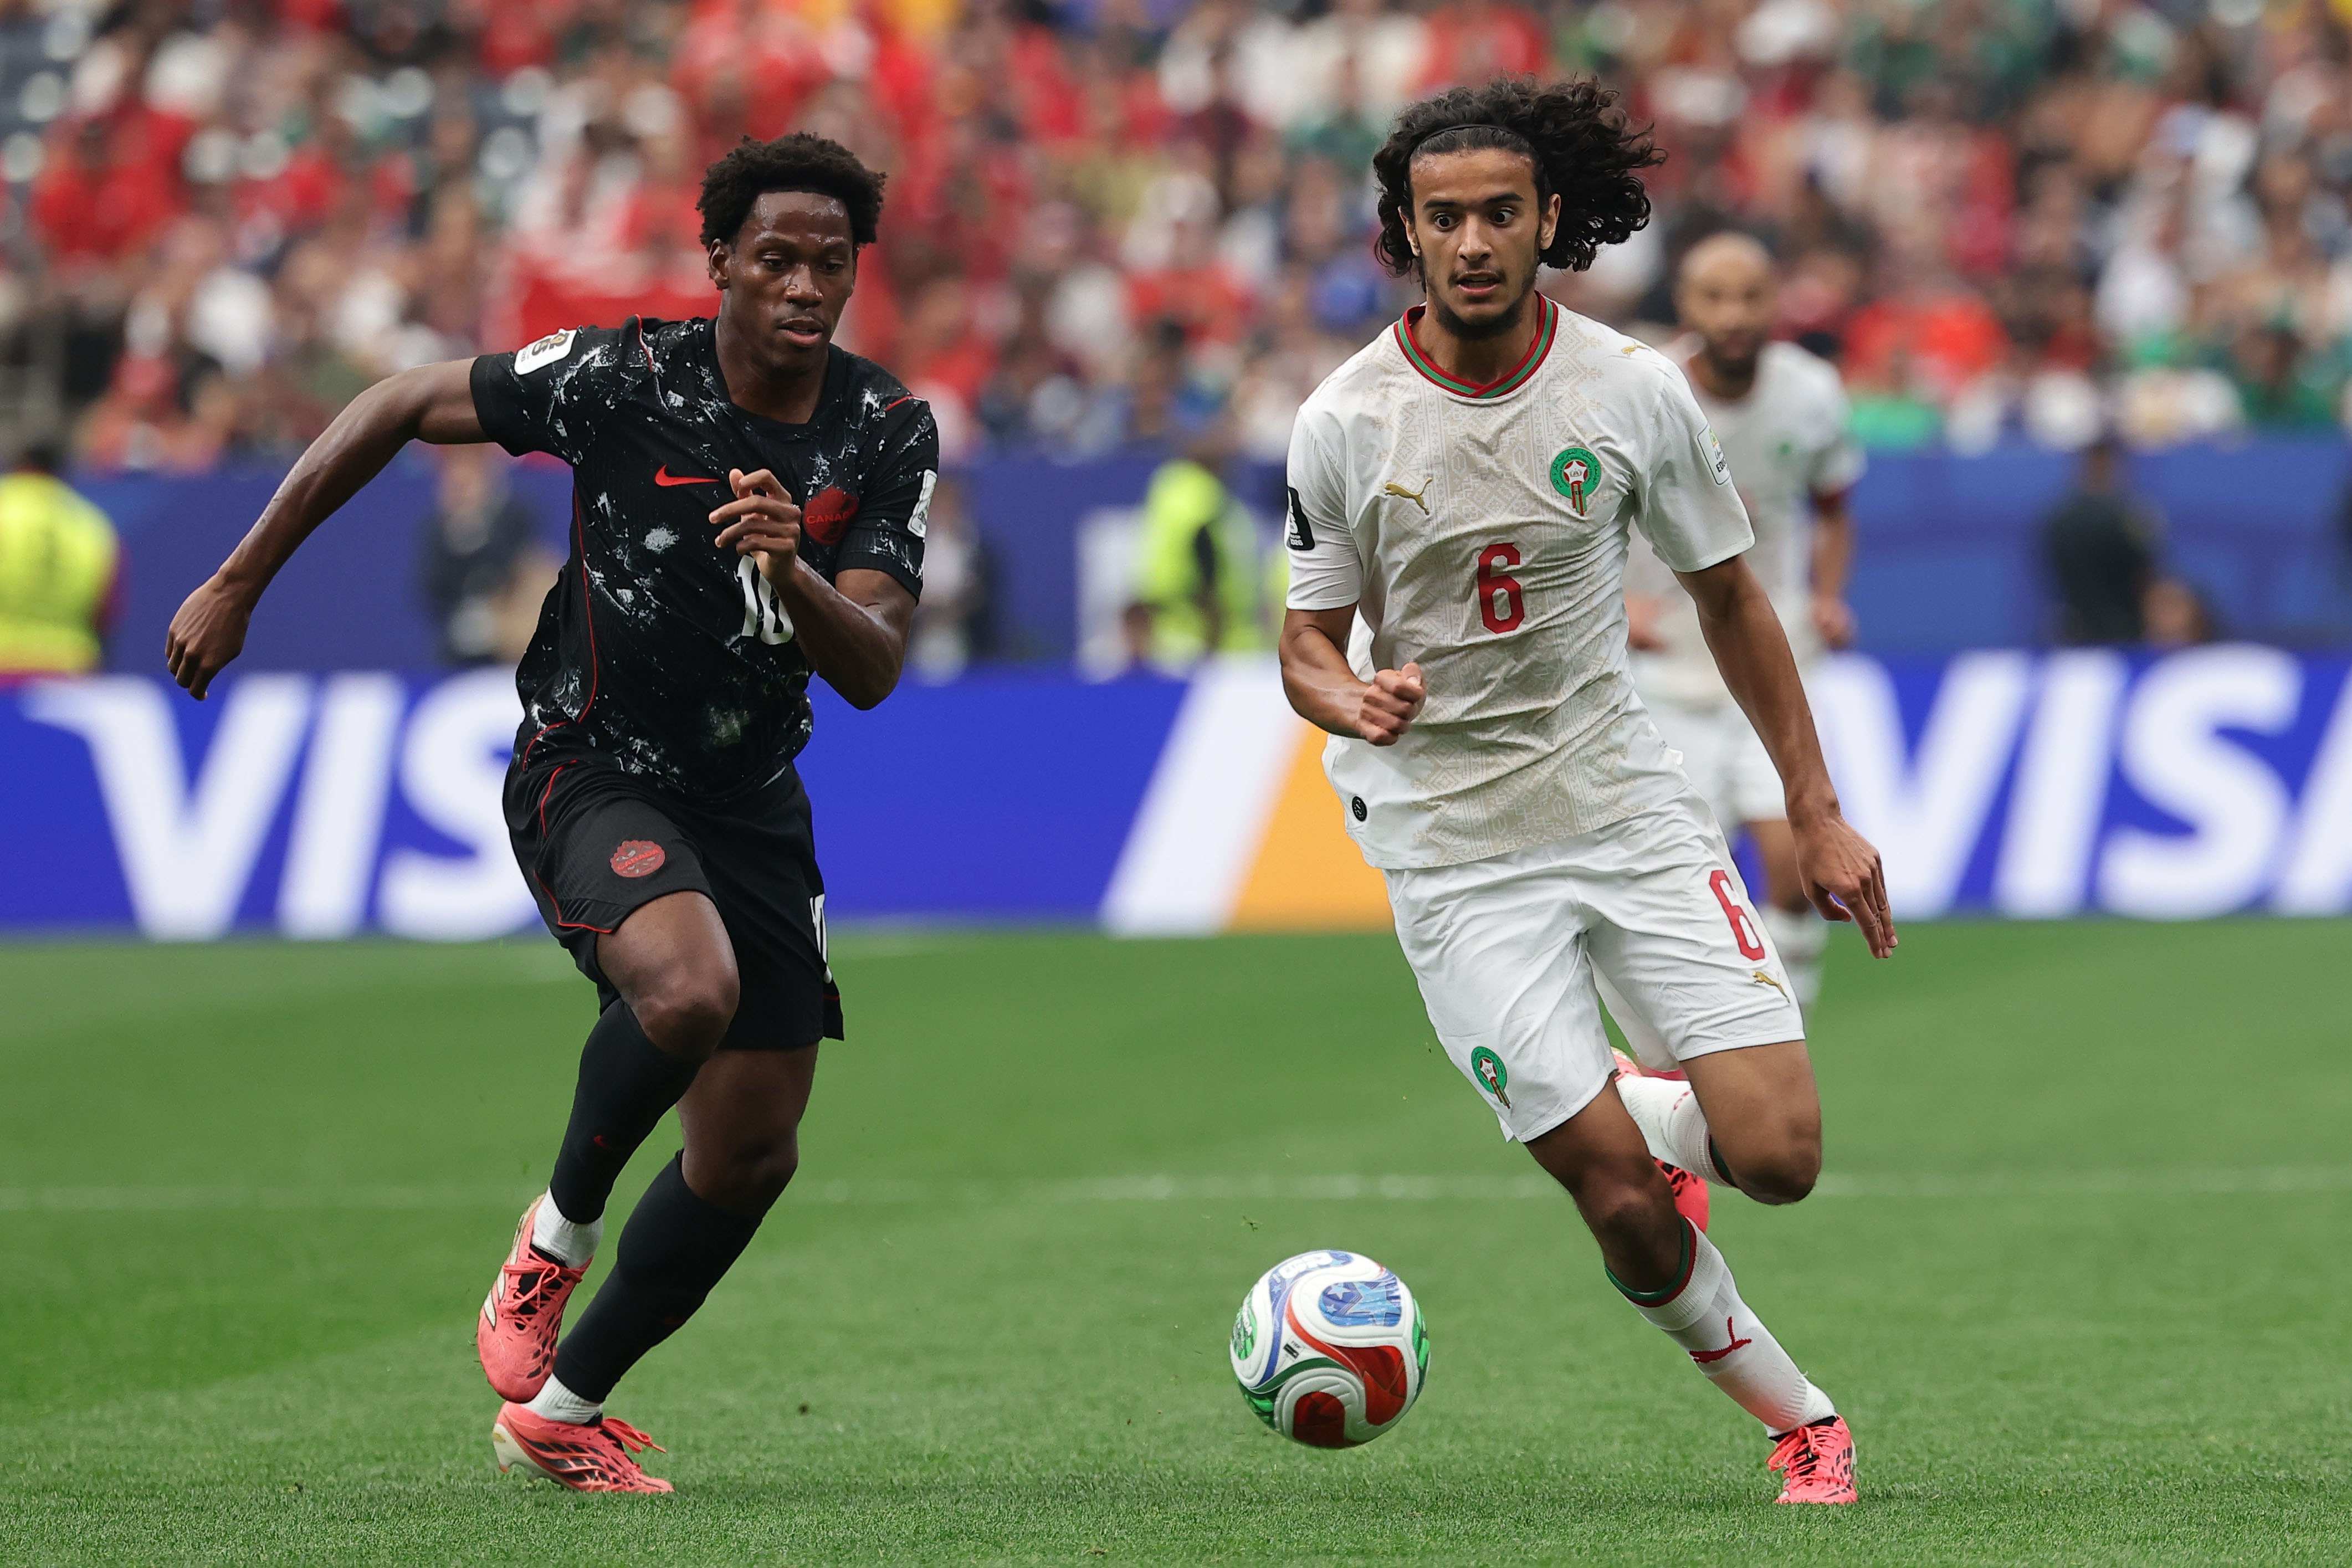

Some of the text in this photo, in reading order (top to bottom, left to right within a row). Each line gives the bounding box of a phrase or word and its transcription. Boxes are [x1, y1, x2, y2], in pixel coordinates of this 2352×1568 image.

[736, 555, 794, 645] 10
[1477, 542, 1525, 634] 6
[19, 672, 546, 942] VIS
[1709, 870, 1766, 961] 6
